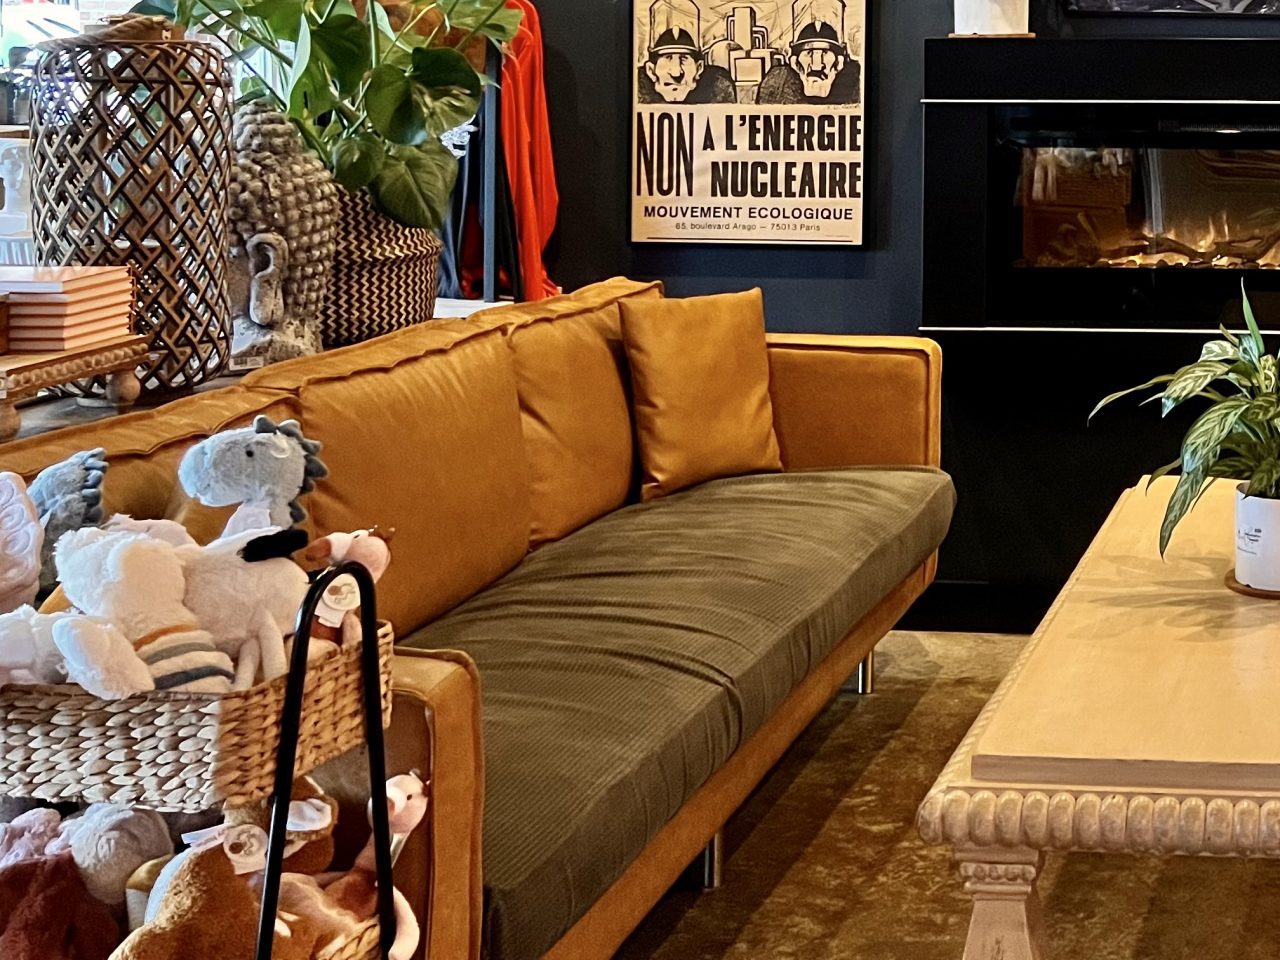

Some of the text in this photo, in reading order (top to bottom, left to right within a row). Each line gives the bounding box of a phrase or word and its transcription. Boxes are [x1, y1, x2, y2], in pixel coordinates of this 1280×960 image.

[636, 112, 861, 197] NON A L'ENERGIE
[710, 161, 861, 198] NUCLEAIRE
[643, 206, 853, 220] MOUVEMENT ECOLOGIQUE
[690, 222, 730, 230] boulevard
[733, 222, 757, 232] Arago
[770, 223, 797, 231] 75013
[800, 223, 820, 231] Paris
